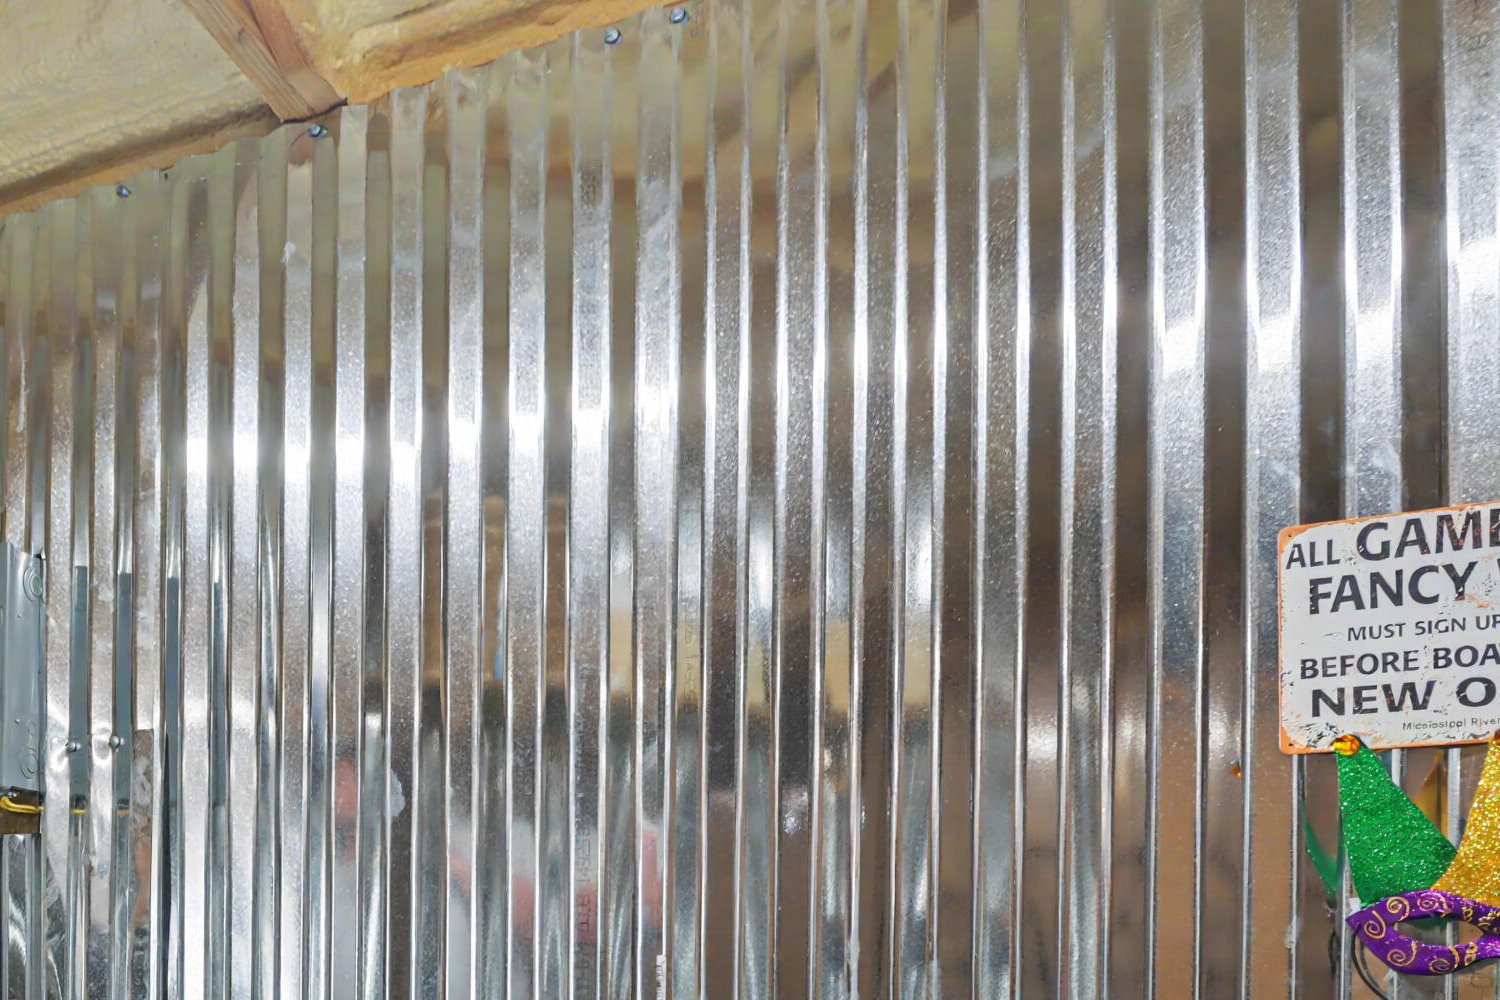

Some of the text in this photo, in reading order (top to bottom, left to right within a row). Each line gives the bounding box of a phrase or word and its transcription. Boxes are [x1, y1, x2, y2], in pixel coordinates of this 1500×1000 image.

[1285, 538, 1341, 570] ALL
[1308, 560, 1479, 615] FANCY
[1347, 622, 1406, 642] MUST
[1414, 616, 1466, 636] SIGN
[1300, 649, 1420, 680] BEFORE
[1311, 679, 1437, 718] NEW
